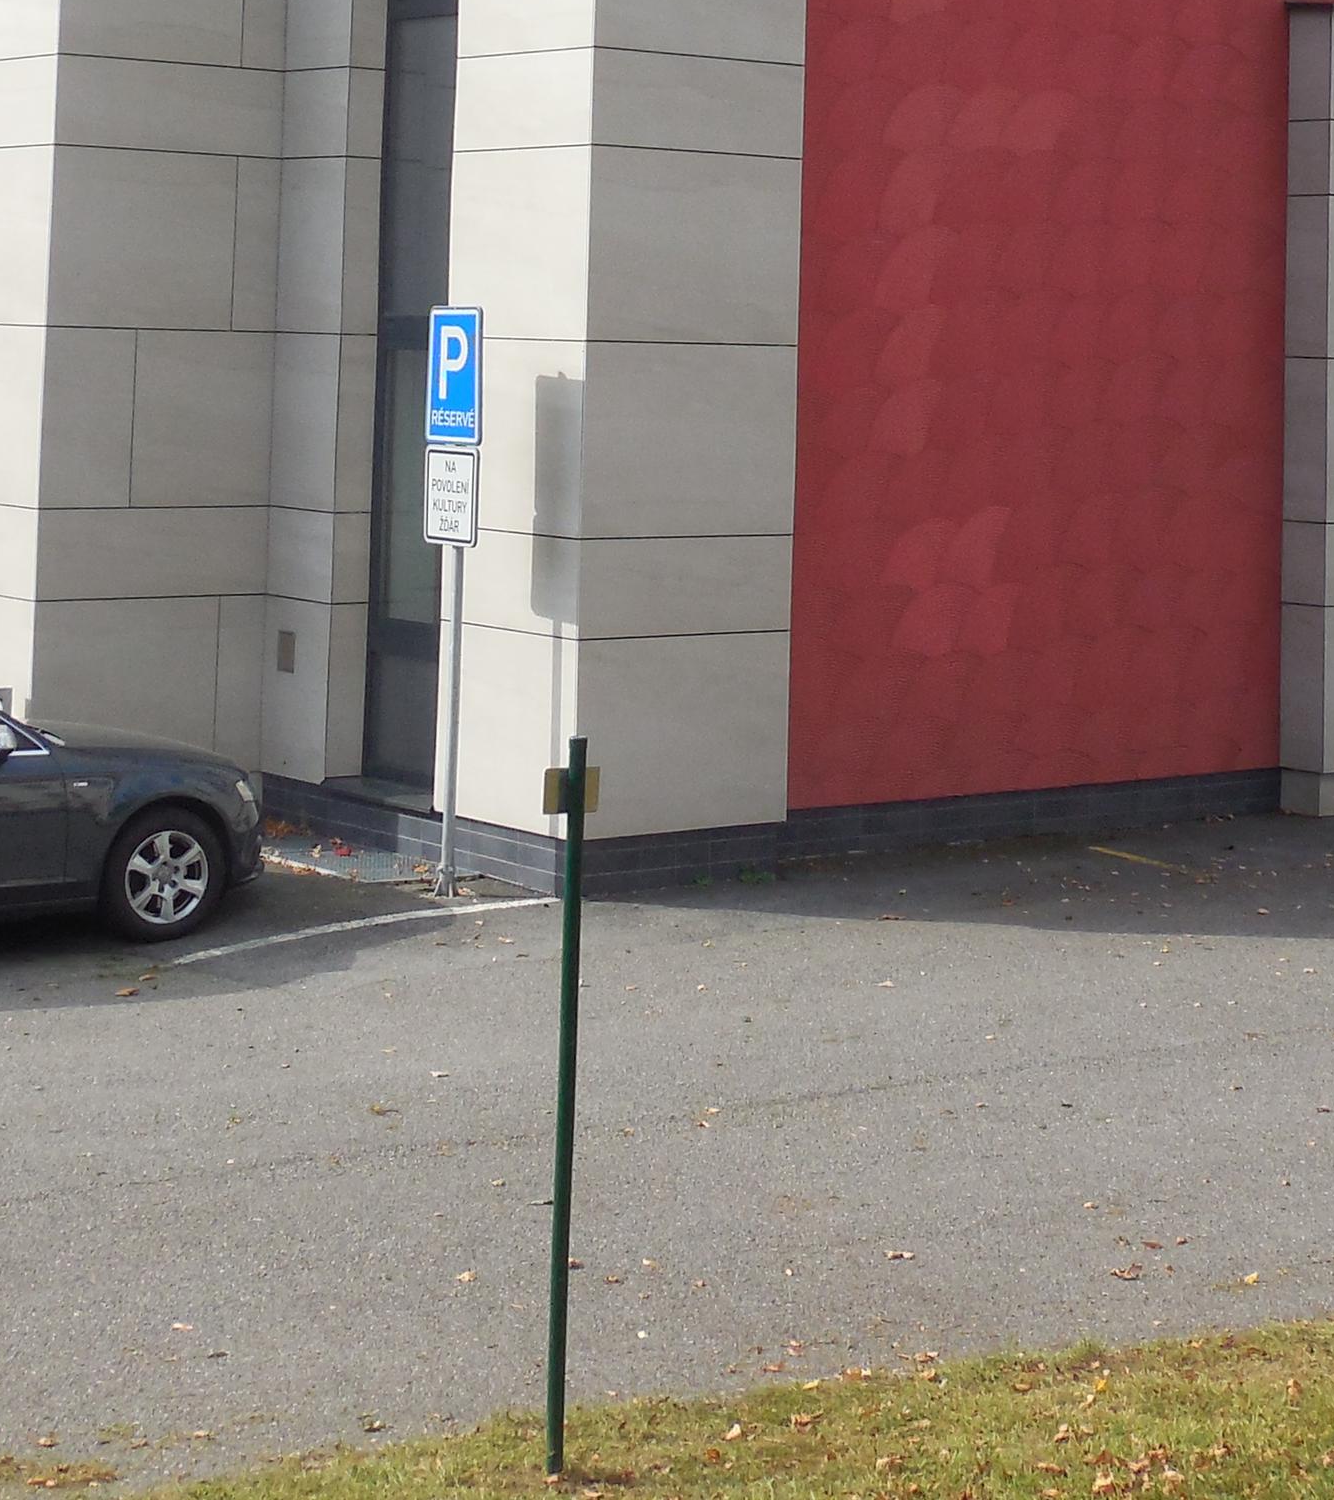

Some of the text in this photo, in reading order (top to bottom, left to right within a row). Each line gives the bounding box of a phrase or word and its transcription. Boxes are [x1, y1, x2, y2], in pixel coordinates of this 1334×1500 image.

[438, 325, 469, 400] P
[431, 408, 475, 428] RÉSERVÉ
[445, 460, 457, 473] NA
[431, 478, 469, 494] POVOLENÍ
[432, 498, 467, 514] KULTURY
